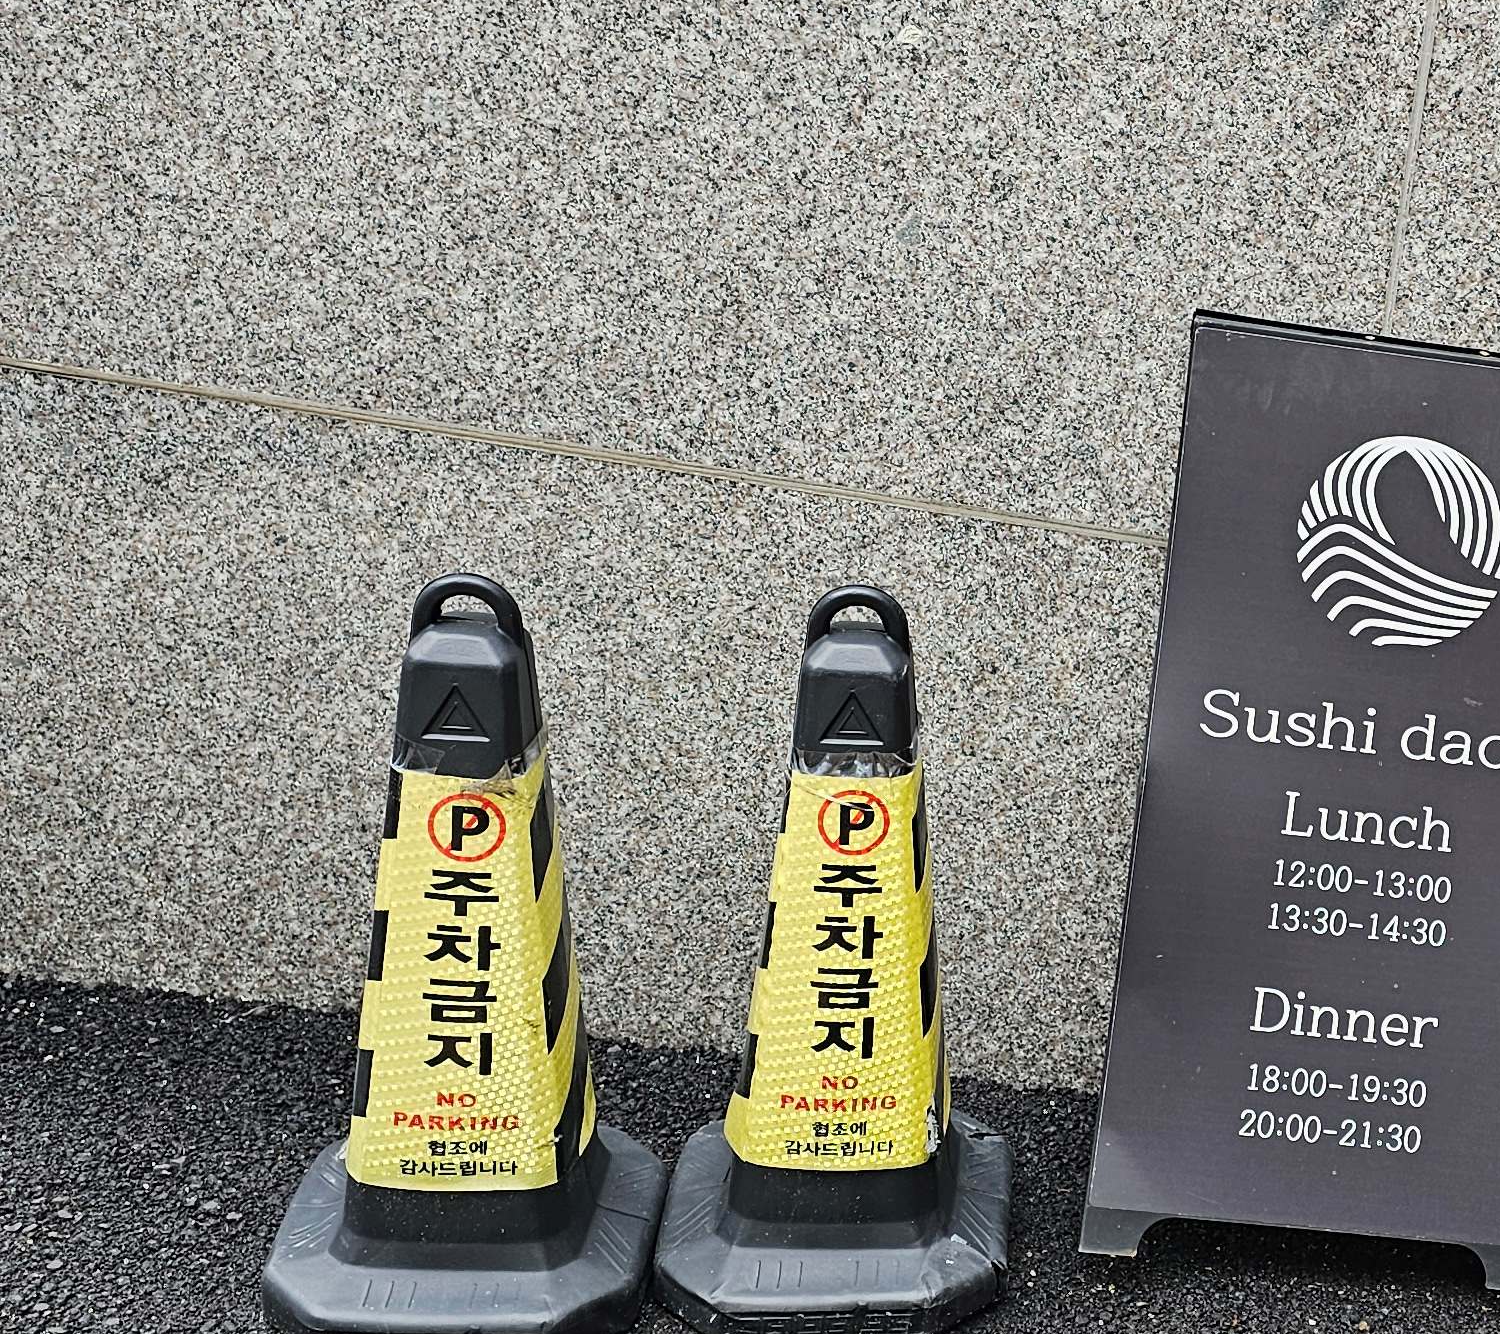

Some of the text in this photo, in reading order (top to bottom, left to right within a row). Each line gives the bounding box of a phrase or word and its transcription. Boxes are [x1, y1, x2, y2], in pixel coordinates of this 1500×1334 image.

[1200, 689, 1377, 755] Sushi
[448, 805, 491, 853] P
[836, 801, 874, 847] P
[1280, 790, 1452, 853] Lunch
[1271, 858, 1452, 905] 12:00-13:00
[1266, 900, 1449, 948] 13:30-14:30
[422, 868, 502, 1076] 주차금지
[809, 864, 884, 1060] 주차금지
[1249, 984, 1439, 1049] Dinner
[436, 1091, 477, 1108] NO
[780, 1094, 897, 1113] PARKING
[821, 1075, 859, 1090] NO
[1246, 1061, 1428, 1110] 18:00-19:30
[393, 1111, 521, 1132] PARKING
[811, 1120, 868, 1138] 협조에
[1238, 1108, 1423, 1155] 20:00-21:30
[399, 1158, 519, 1177] 감사드립니다
[428, 1140, 488, 1157] 협조에
[784, 1139, 894, 1157] 감사드립니다
